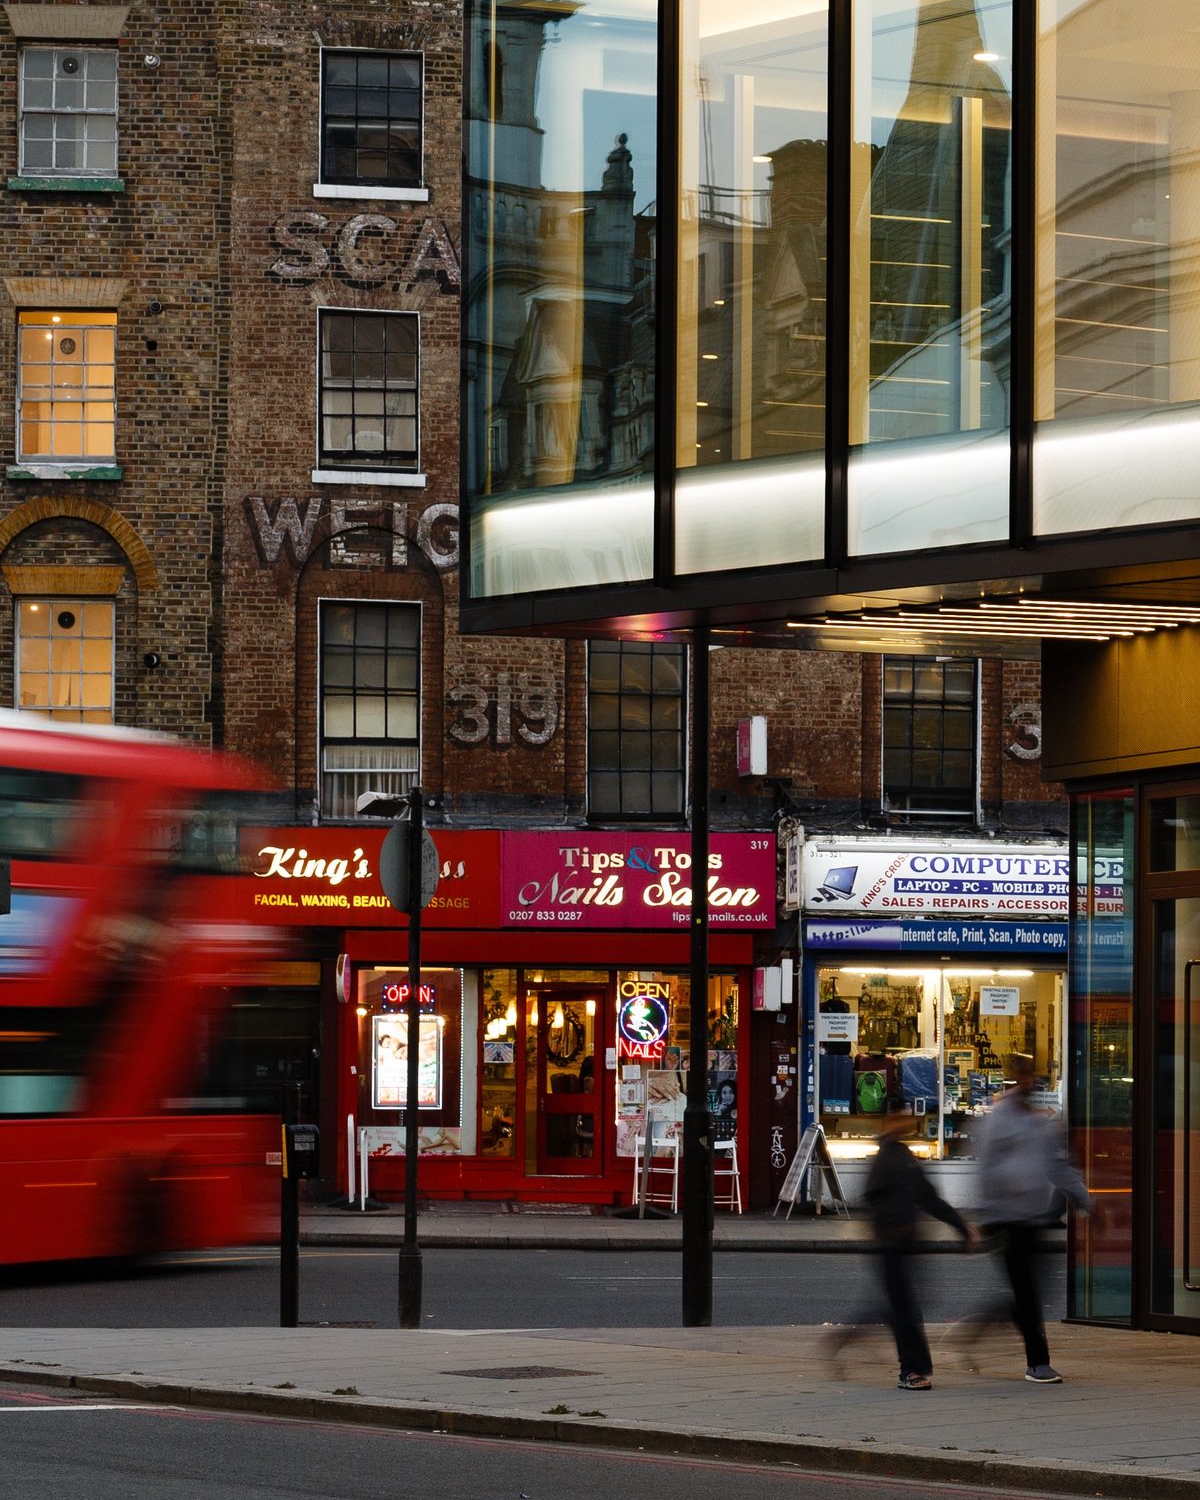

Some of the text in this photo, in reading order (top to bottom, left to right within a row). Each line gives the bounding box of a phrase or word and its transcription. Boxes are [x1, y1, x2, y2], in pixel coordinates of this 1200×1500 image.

[270, 212, 462, 285] SCA
[450, 683, 559, 745] 319
[750, 840, 769, 850] 319
[254, 846, 373, 886] King's
[559, 846, 723, 874] Tips & Tos
[909, 856, 1070, 877] COMPUTER
[518, 870, 625, 906] Nails
[860, 878, 887, 909] KING'S
[897, 880, 950, 893] LAPTOP
[962, 882, 980, 893] PC
[992, 883, 1045, 895] MOBILE
[254, 894, 470, 909] FACIAL, WAXING, BEAUT SSAGE
[882, 897, 924, 908] SALES
[933, 898, 989, 909] REPAIRS
[997, 899, 1088, 912] ACCESSORES
[509, 911, 583, 921] 0207 833 0287
[900, 927, 936, 942] Internet
[937, 928, 960, 945] cafe,
[962, 928, 987, 944] Print,
[989, 928, 1013, 945] Scan,
[1015, 928, 1041, 944] Photo
[1042, 933, 1067, 947] copy,
[387, 986, 431, 1003] OPN
[620, 981, 670, 999] OPEN
[618, 1037, 666, 1059] NAILS
